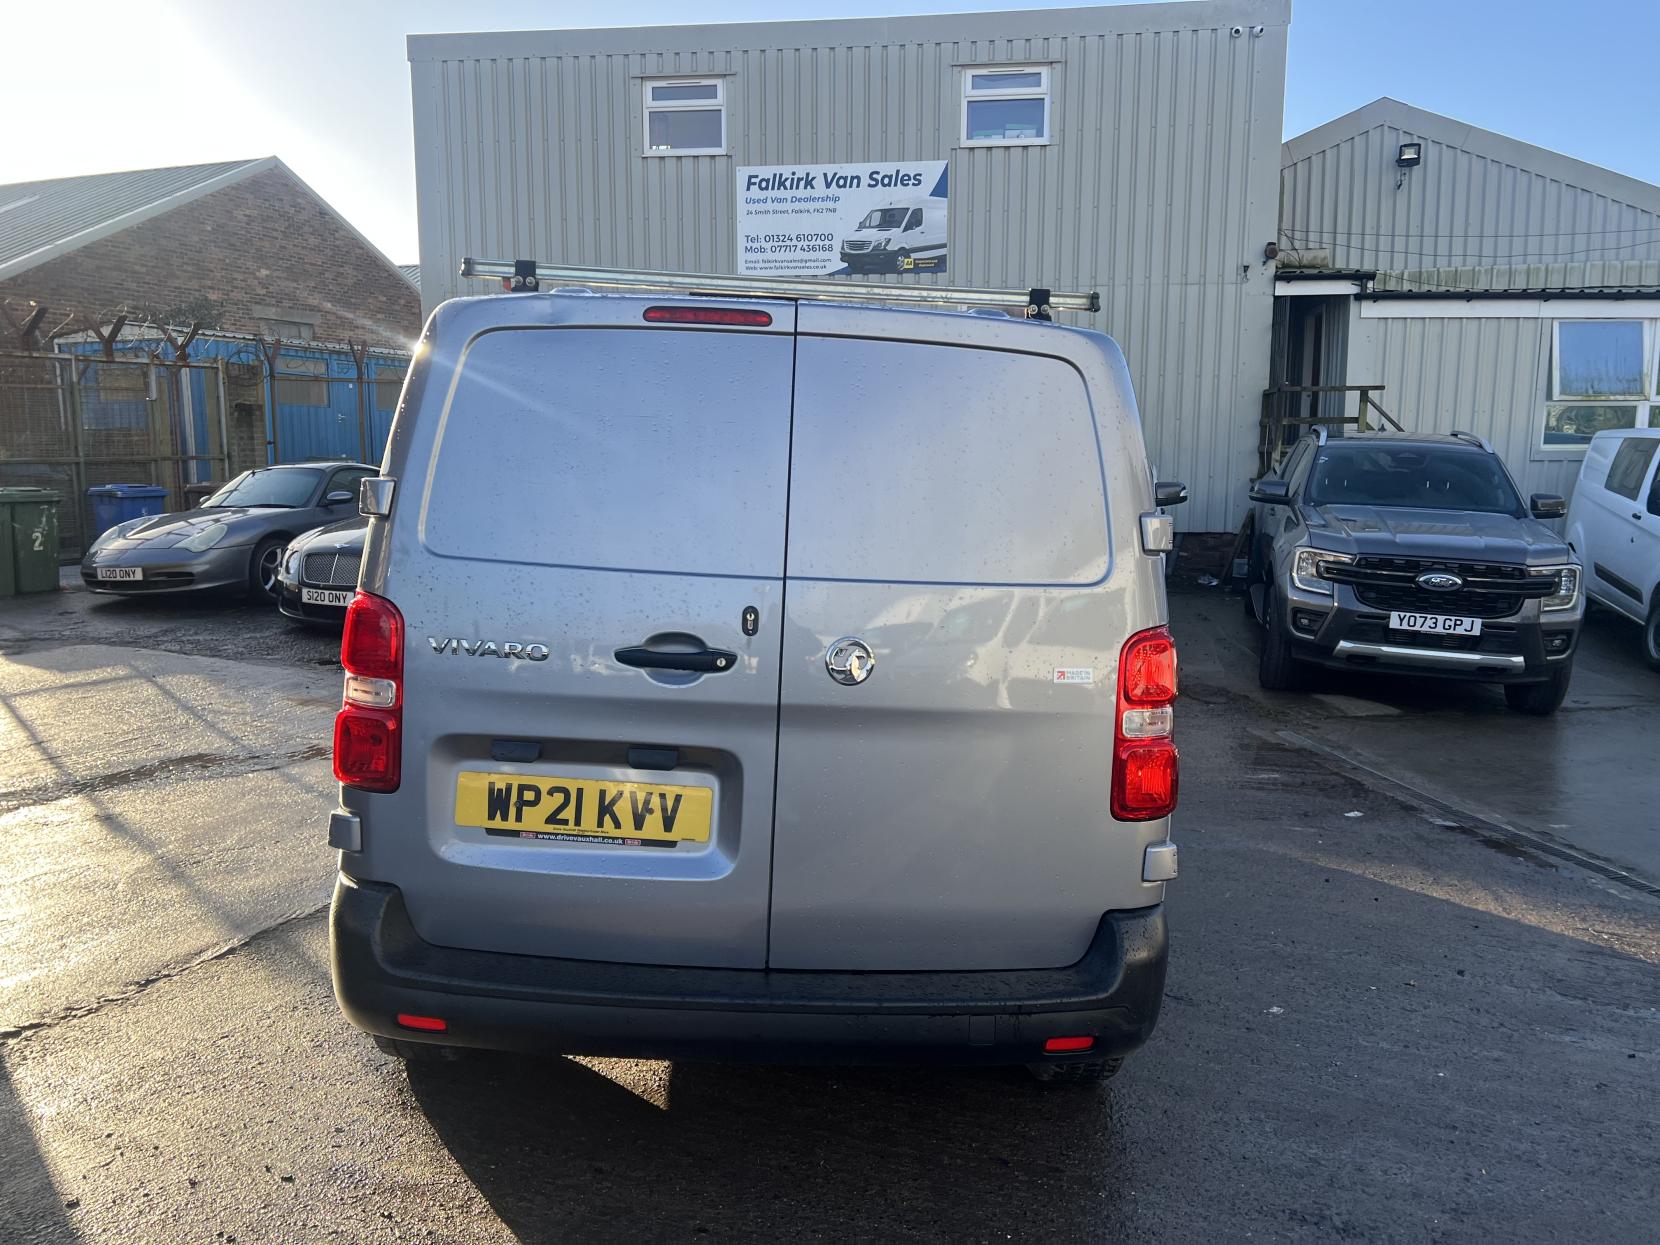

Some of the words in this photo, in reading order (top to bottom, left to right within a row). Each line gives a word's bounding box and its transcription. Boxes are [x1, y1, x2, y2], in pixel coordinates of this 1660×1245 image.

[746, 171, 816, 191] Falkirk
[823, 172, 861, 189] Van
[867, 169, 922, 188] Sales
[745, 196, 768, 204] Used
[770, 196, 788, 204] Van
[790, 194, 840, 204] Dealership
[744, 234, 762, 243] Tel:
[764, 234, 793, 243] 01324
[796, 233, 834, 242] 610700
[744, 246, 769, 254] Mob:
[770, 245, 798, 253] 07717
[800, 244, 834, 252] 436168
[32, 533, 43, 550] 2
[119, 569, 136, 578] ONY
[306, 590, 325, 602] S120
[328, 592, 347, 604] ONY
[1398, 613, 1438, 629] YO73
[1442, 617, 1475, 632] GPJ
[427, 637, 549, 662] VIVARO
[487, 781, 583, 827] WP21
[597, 789, 682, 833] KVV
[537, 832, 623, 845] www.drivevauxhall.co.uk
